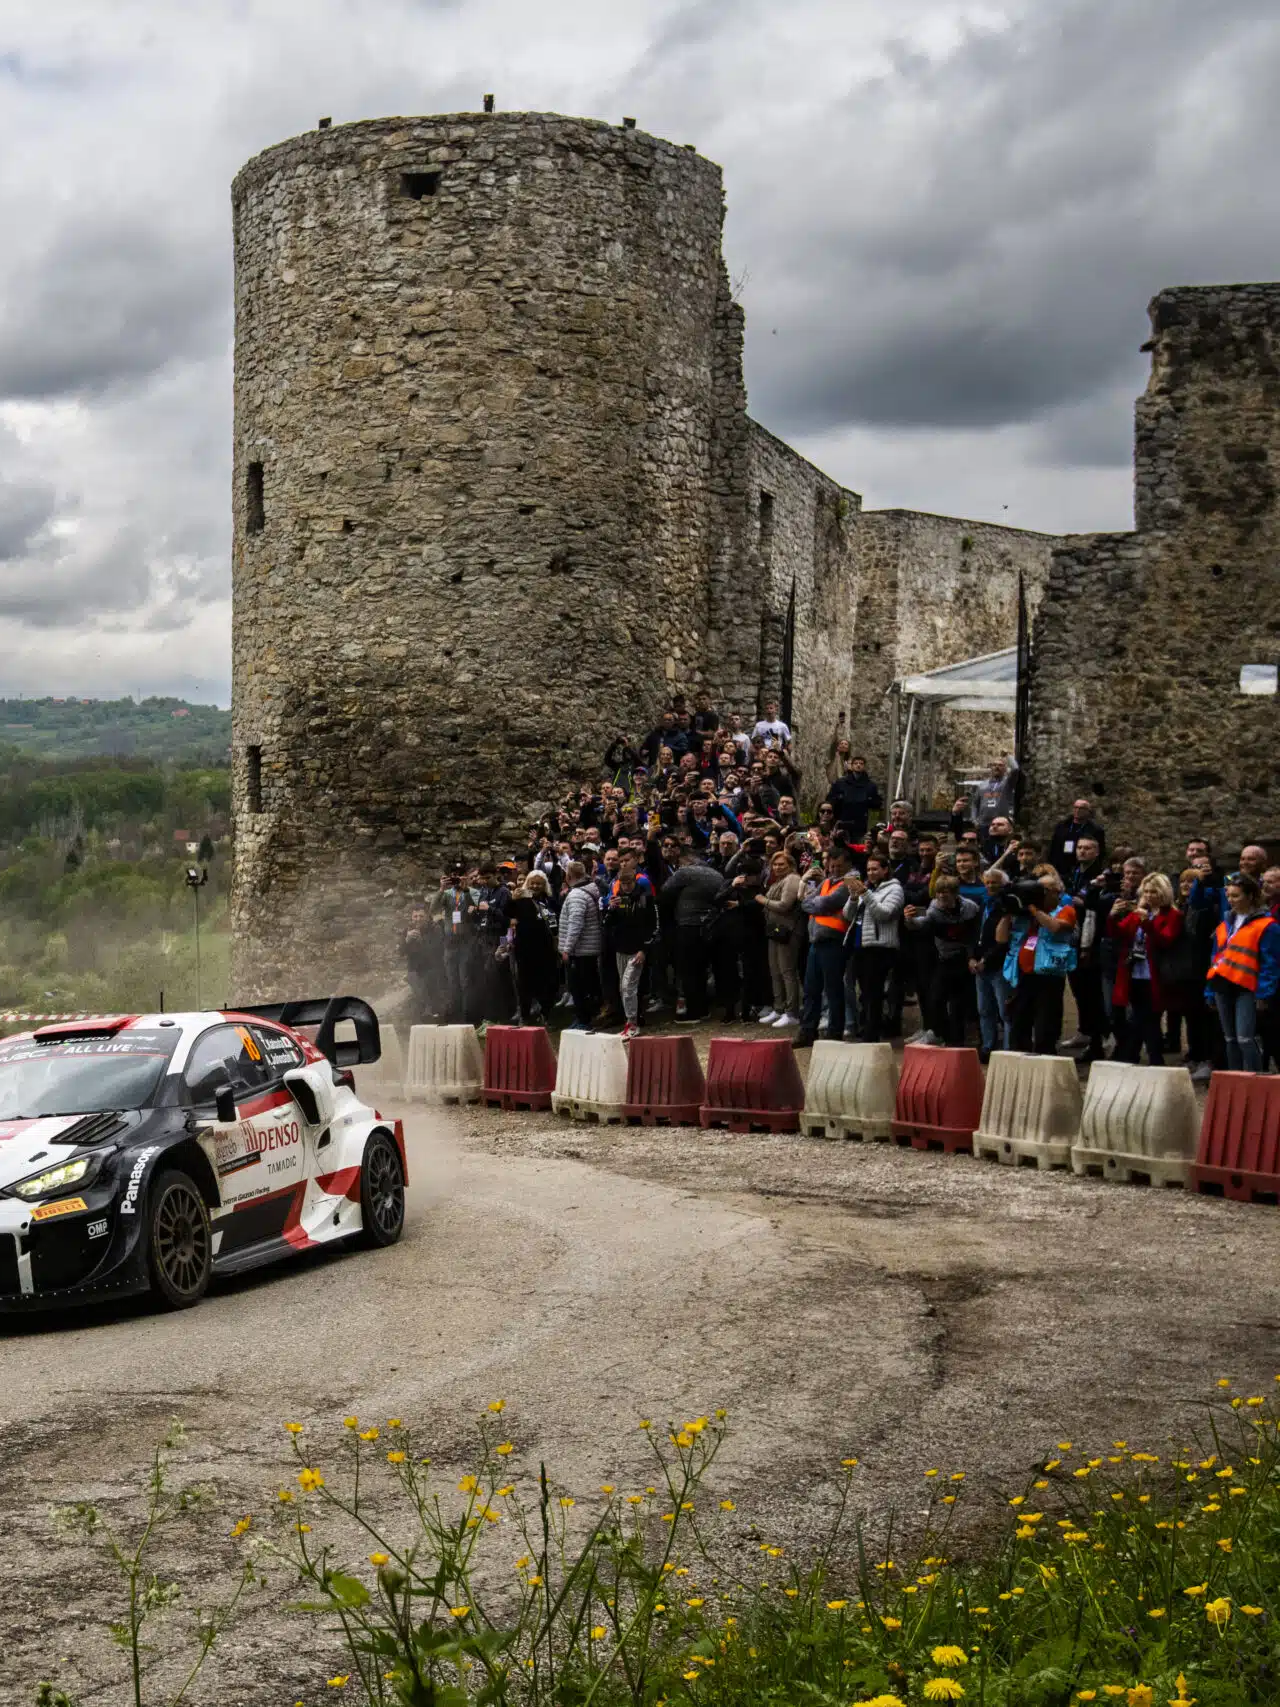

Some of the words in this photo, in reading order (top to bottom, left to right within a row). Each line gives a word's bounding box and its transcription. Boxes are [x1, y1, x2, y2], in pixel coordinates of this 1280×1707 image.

[63, 1044, 93, 1055] ALL
[97, 1043, 132, 1053] LIVE
[257, 1121, 299, 1152] DENSO
[267, 1155, 297, 1175] TAMADIC
[87, 1221, 108, 1236] OMP
